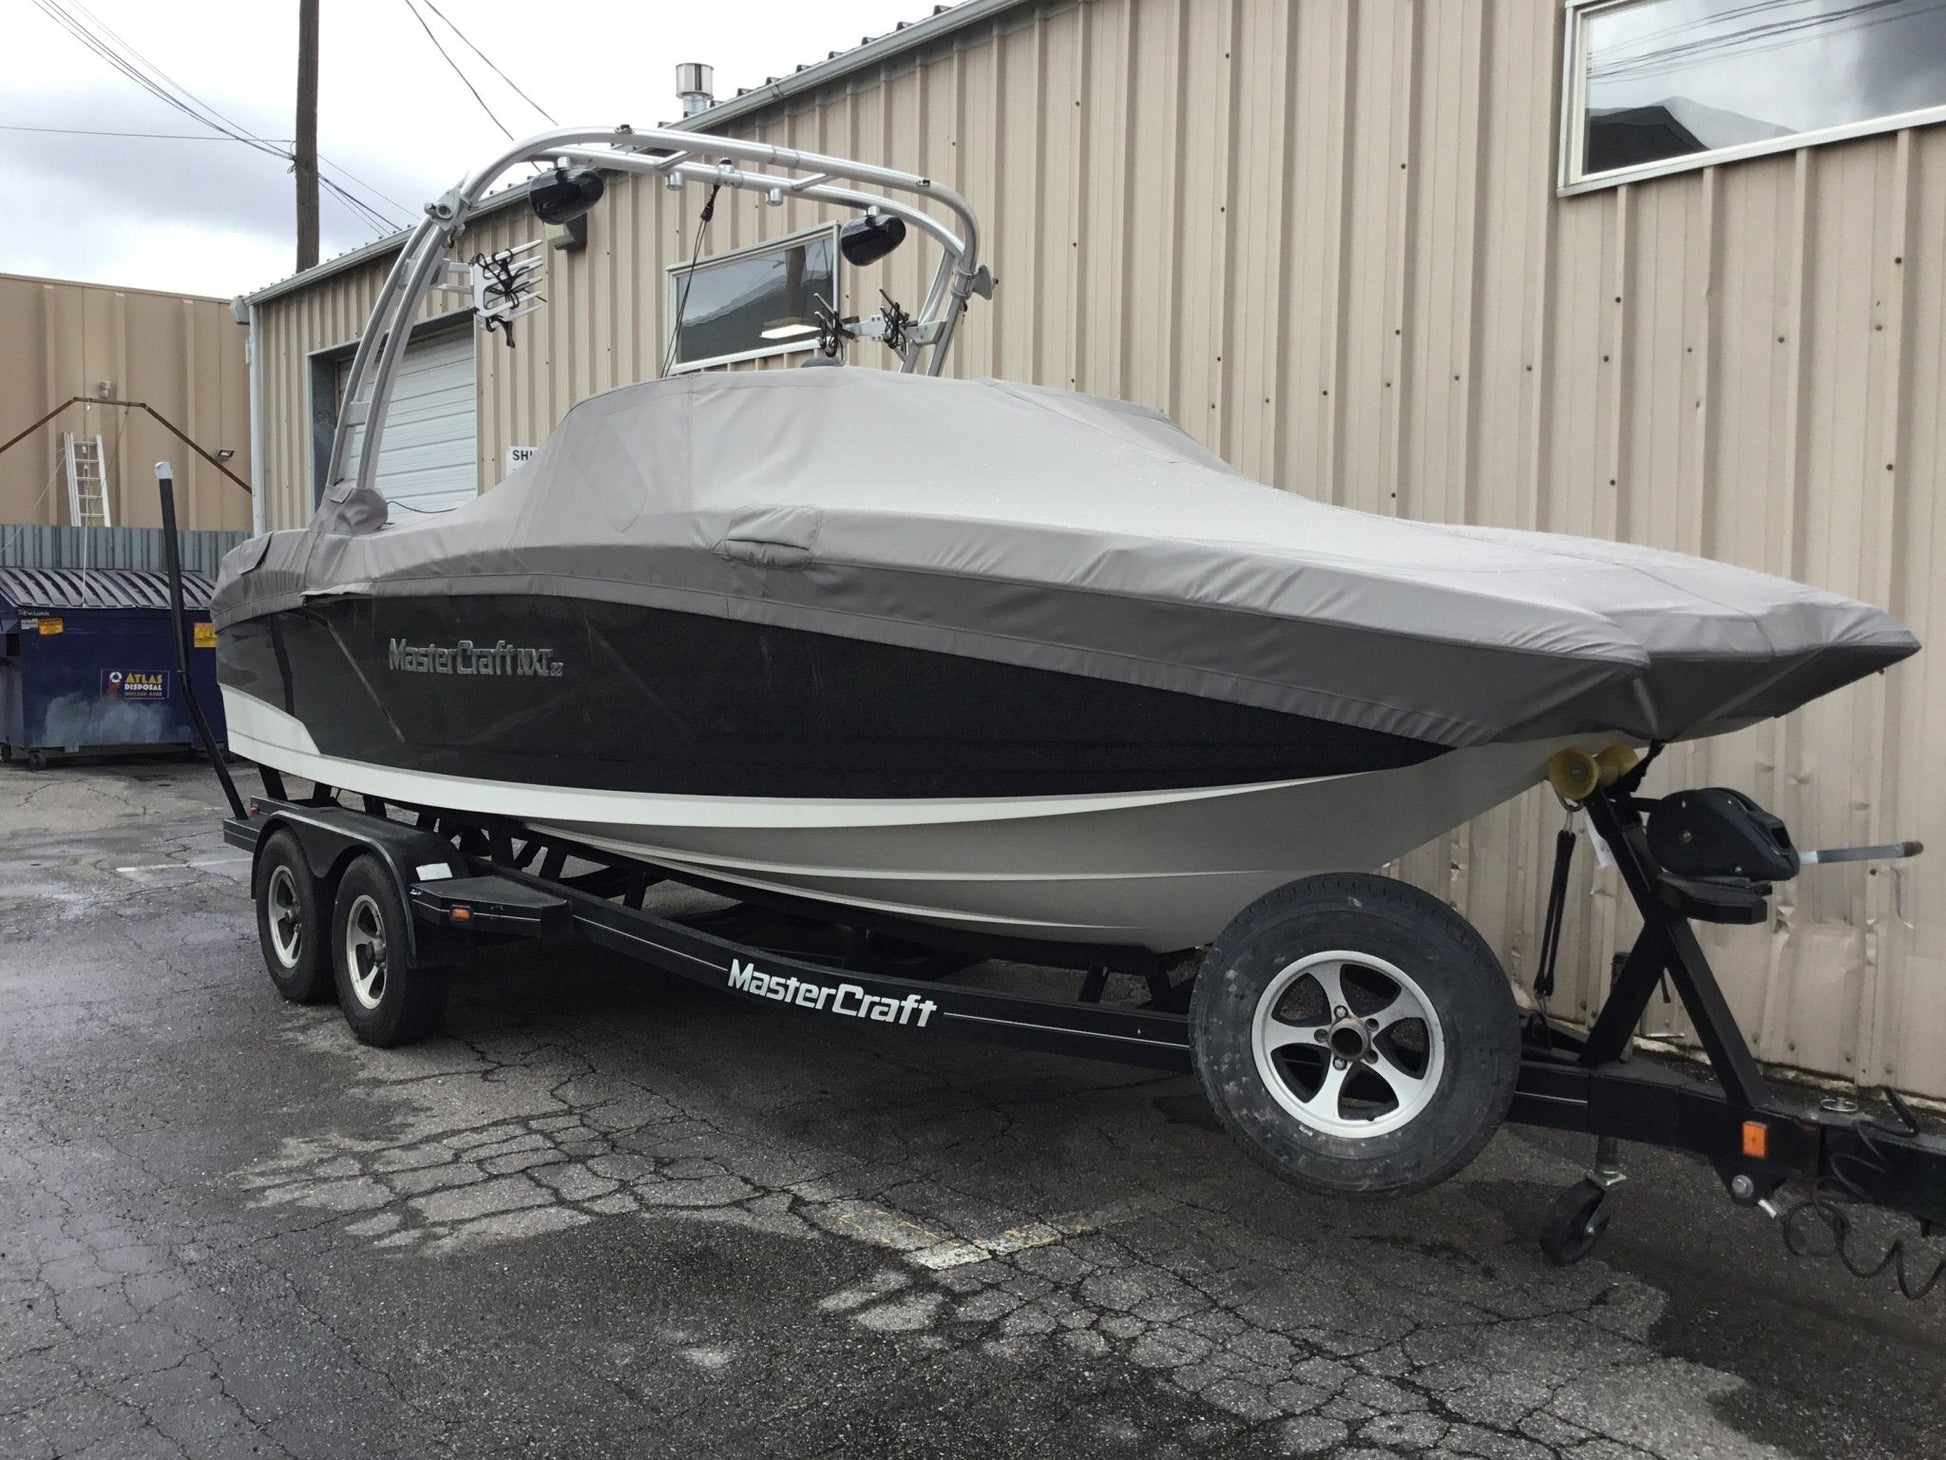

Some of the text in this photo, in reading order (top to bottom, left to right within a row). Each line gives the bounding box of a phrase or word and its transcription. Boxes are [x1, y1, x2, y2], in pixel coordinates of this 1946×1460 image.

[389, 638, 514, 676] MasterCraft
[124, 683, 163, 691] DISPOSAL
[125, 672, 163, 684] ATLAS
[727, 958, 938, 1028] MasterCraft
